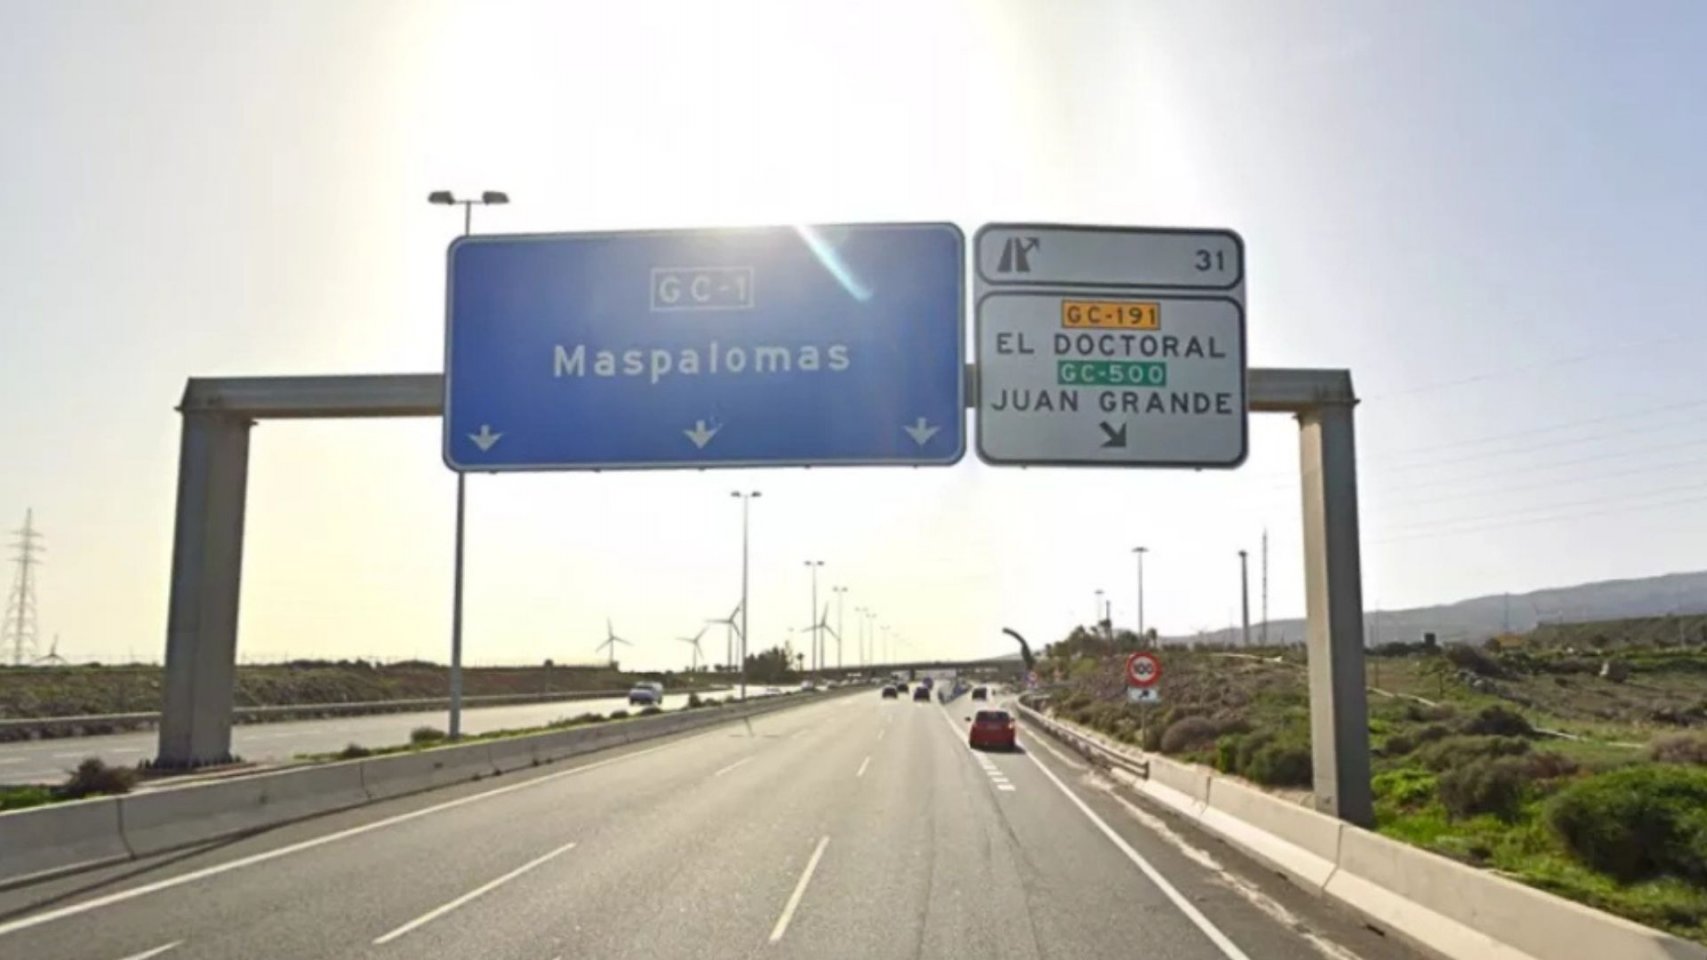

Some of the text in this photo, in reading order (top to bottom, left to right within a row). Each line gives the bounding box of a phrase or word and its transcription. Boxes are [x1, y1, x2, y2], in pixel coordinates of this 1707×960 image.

[1195, 249, 1225, 272] 31
[658, 276, 748, 303] GC-1
[1066, 305, 1157, 325] GC-191
[996, 332, 1226, 358] EL DOCTORAL
[552, 341, 851, 384] Maspalomas
[1060, 364, 1164, 384] GC-500
[991, 390, 1233, 415] JUAN GRANDE
